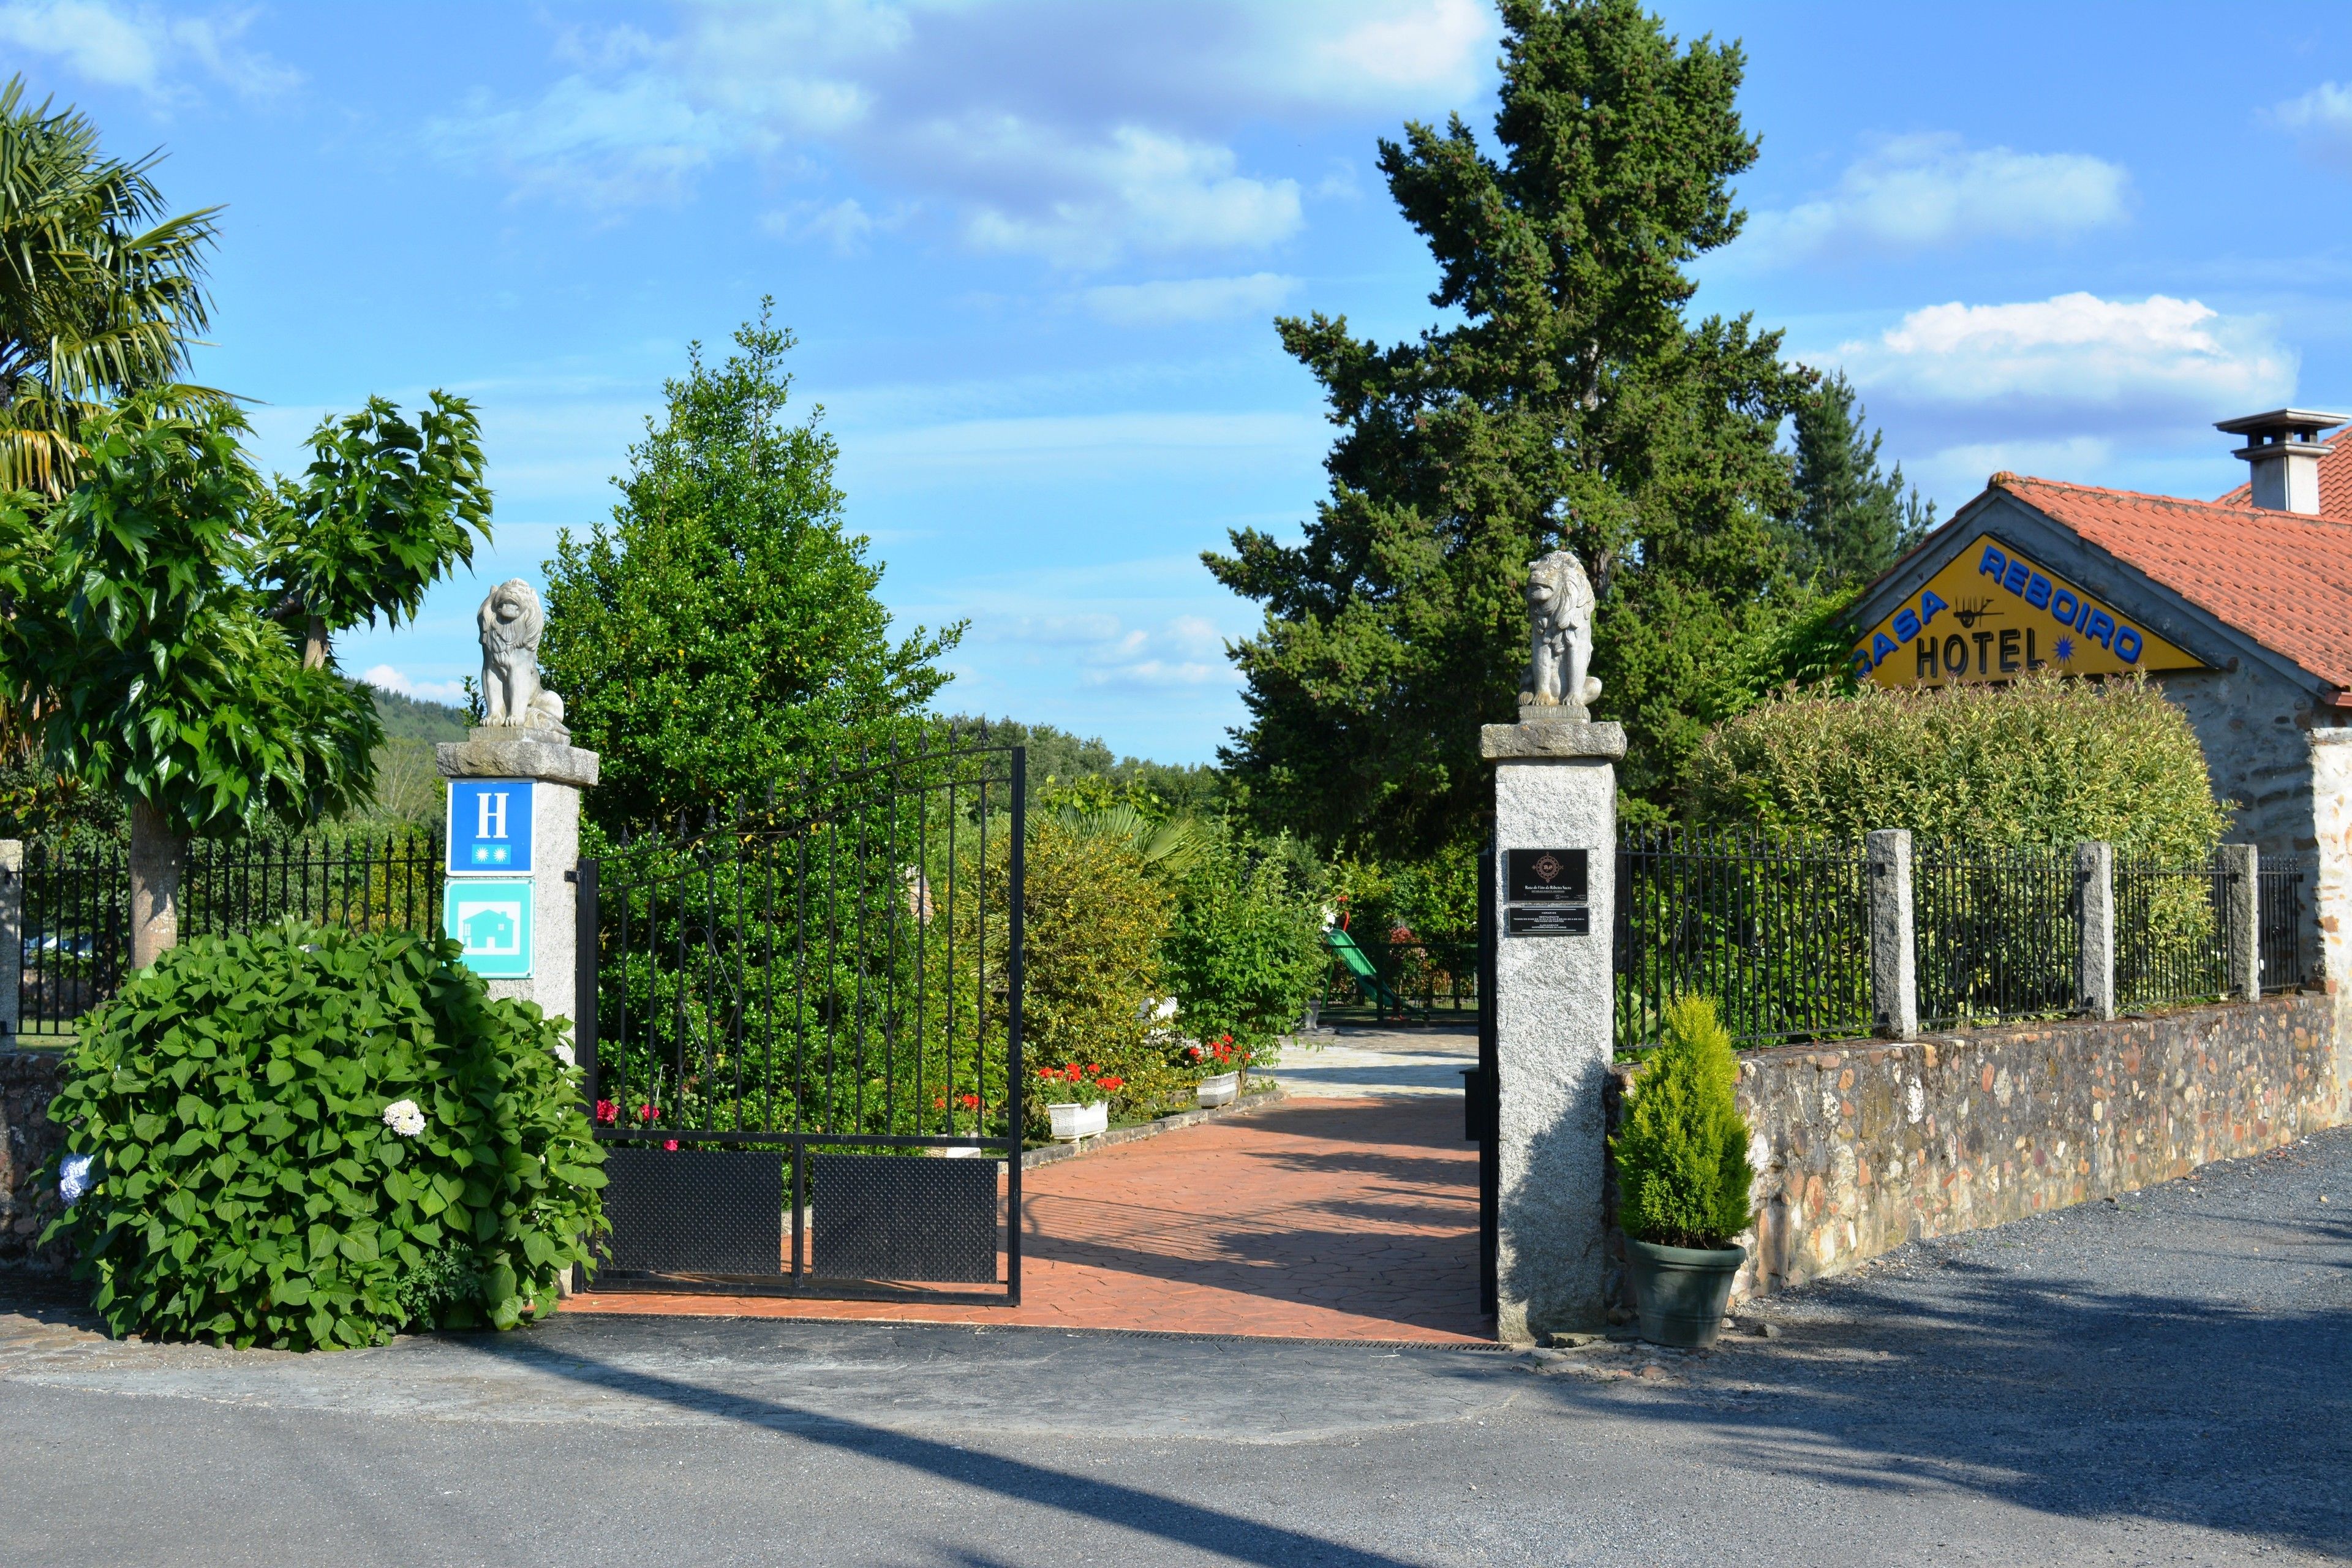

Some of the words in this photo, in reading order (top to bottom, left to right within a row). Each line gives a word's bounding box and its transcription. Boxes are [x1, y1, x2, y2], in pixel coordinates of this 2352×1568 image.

[1978, 544, 2143, 665] REBOIRO
[1916, 627, 2046, 679] HOTEL
[475, 792, 510, 839] H
